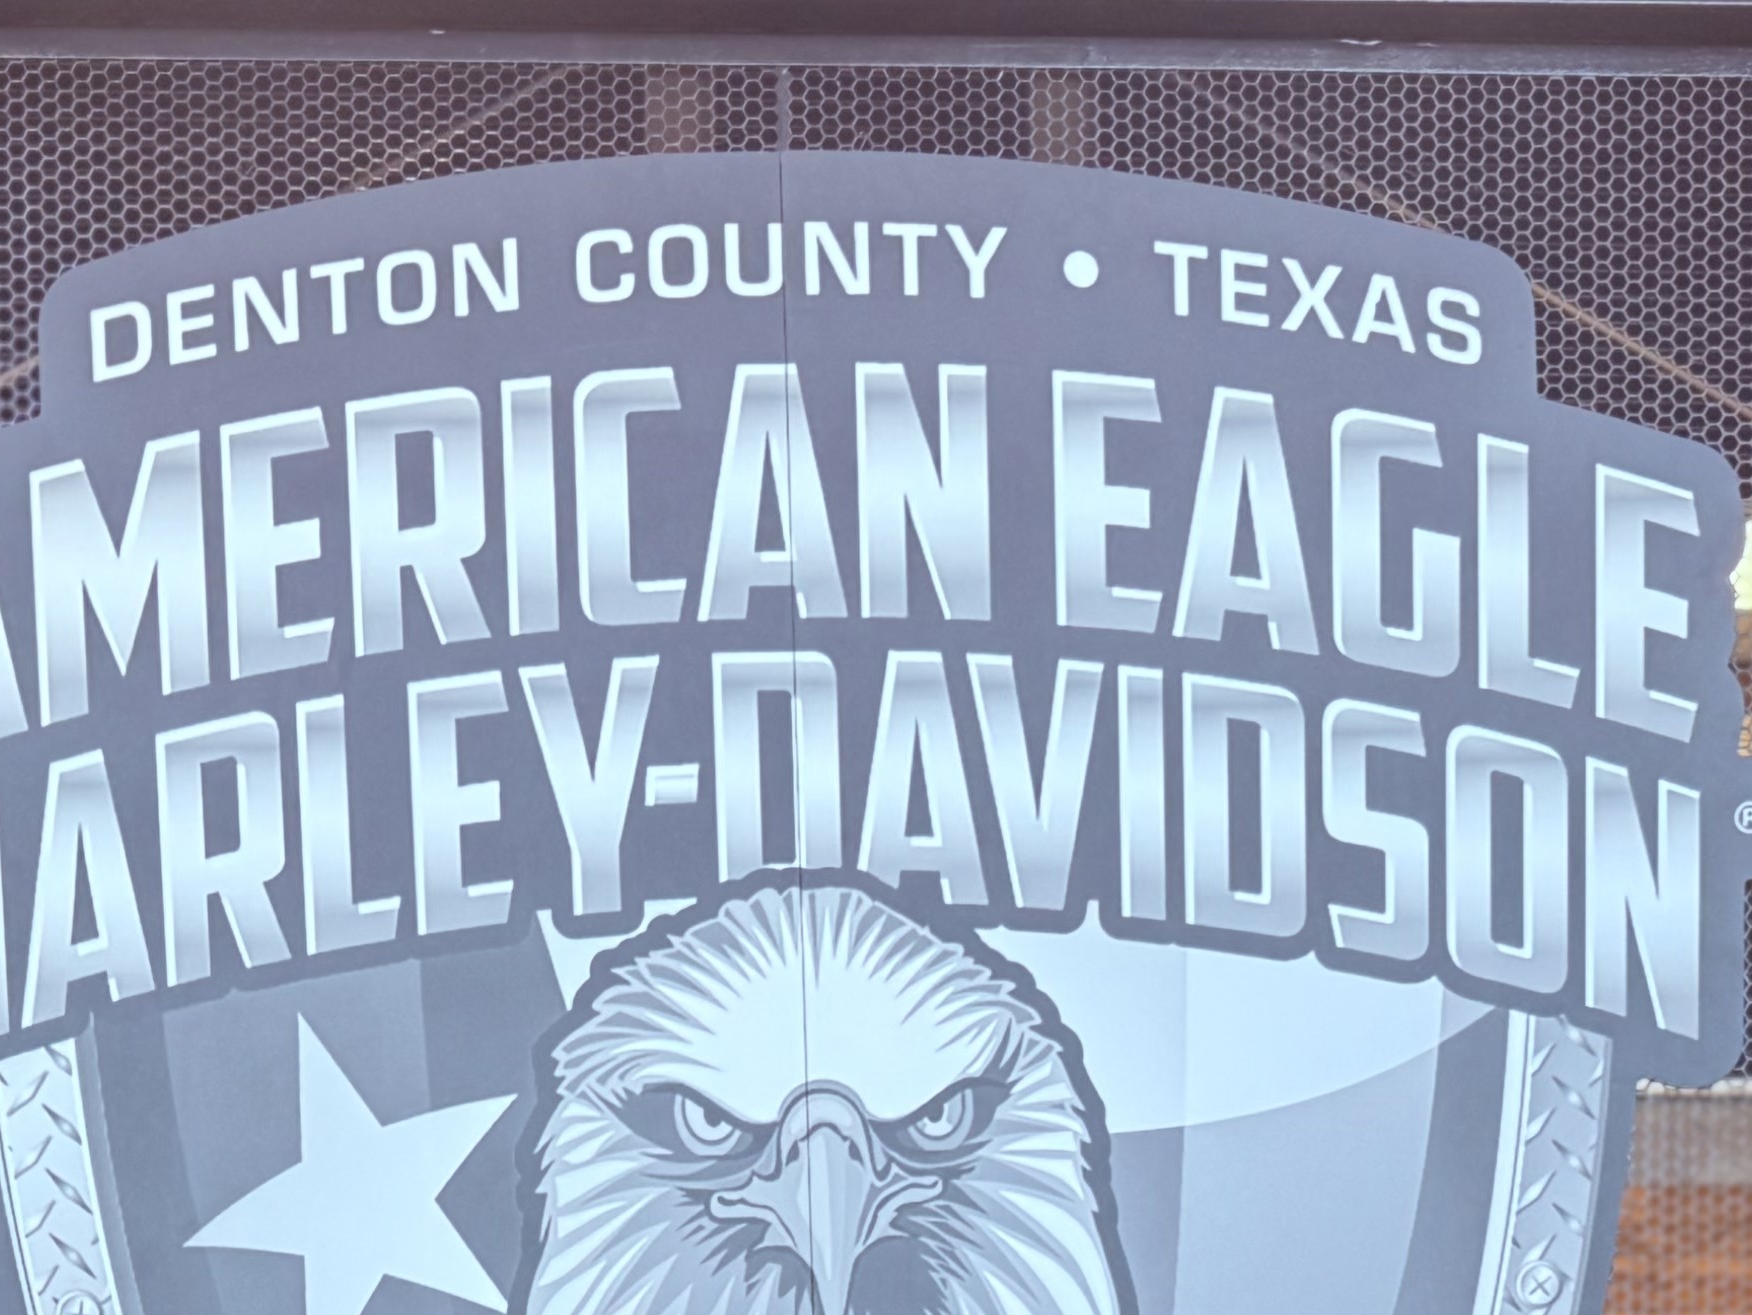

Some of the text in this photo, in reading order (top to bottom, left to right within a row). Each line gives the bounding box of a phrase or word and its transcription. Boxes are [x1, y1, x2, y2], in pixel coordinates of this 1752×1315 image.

[89, 220, 1485, 384] DENTON COUNTY TEXAS
[1052, 366, 1703, 741] EAGLE
